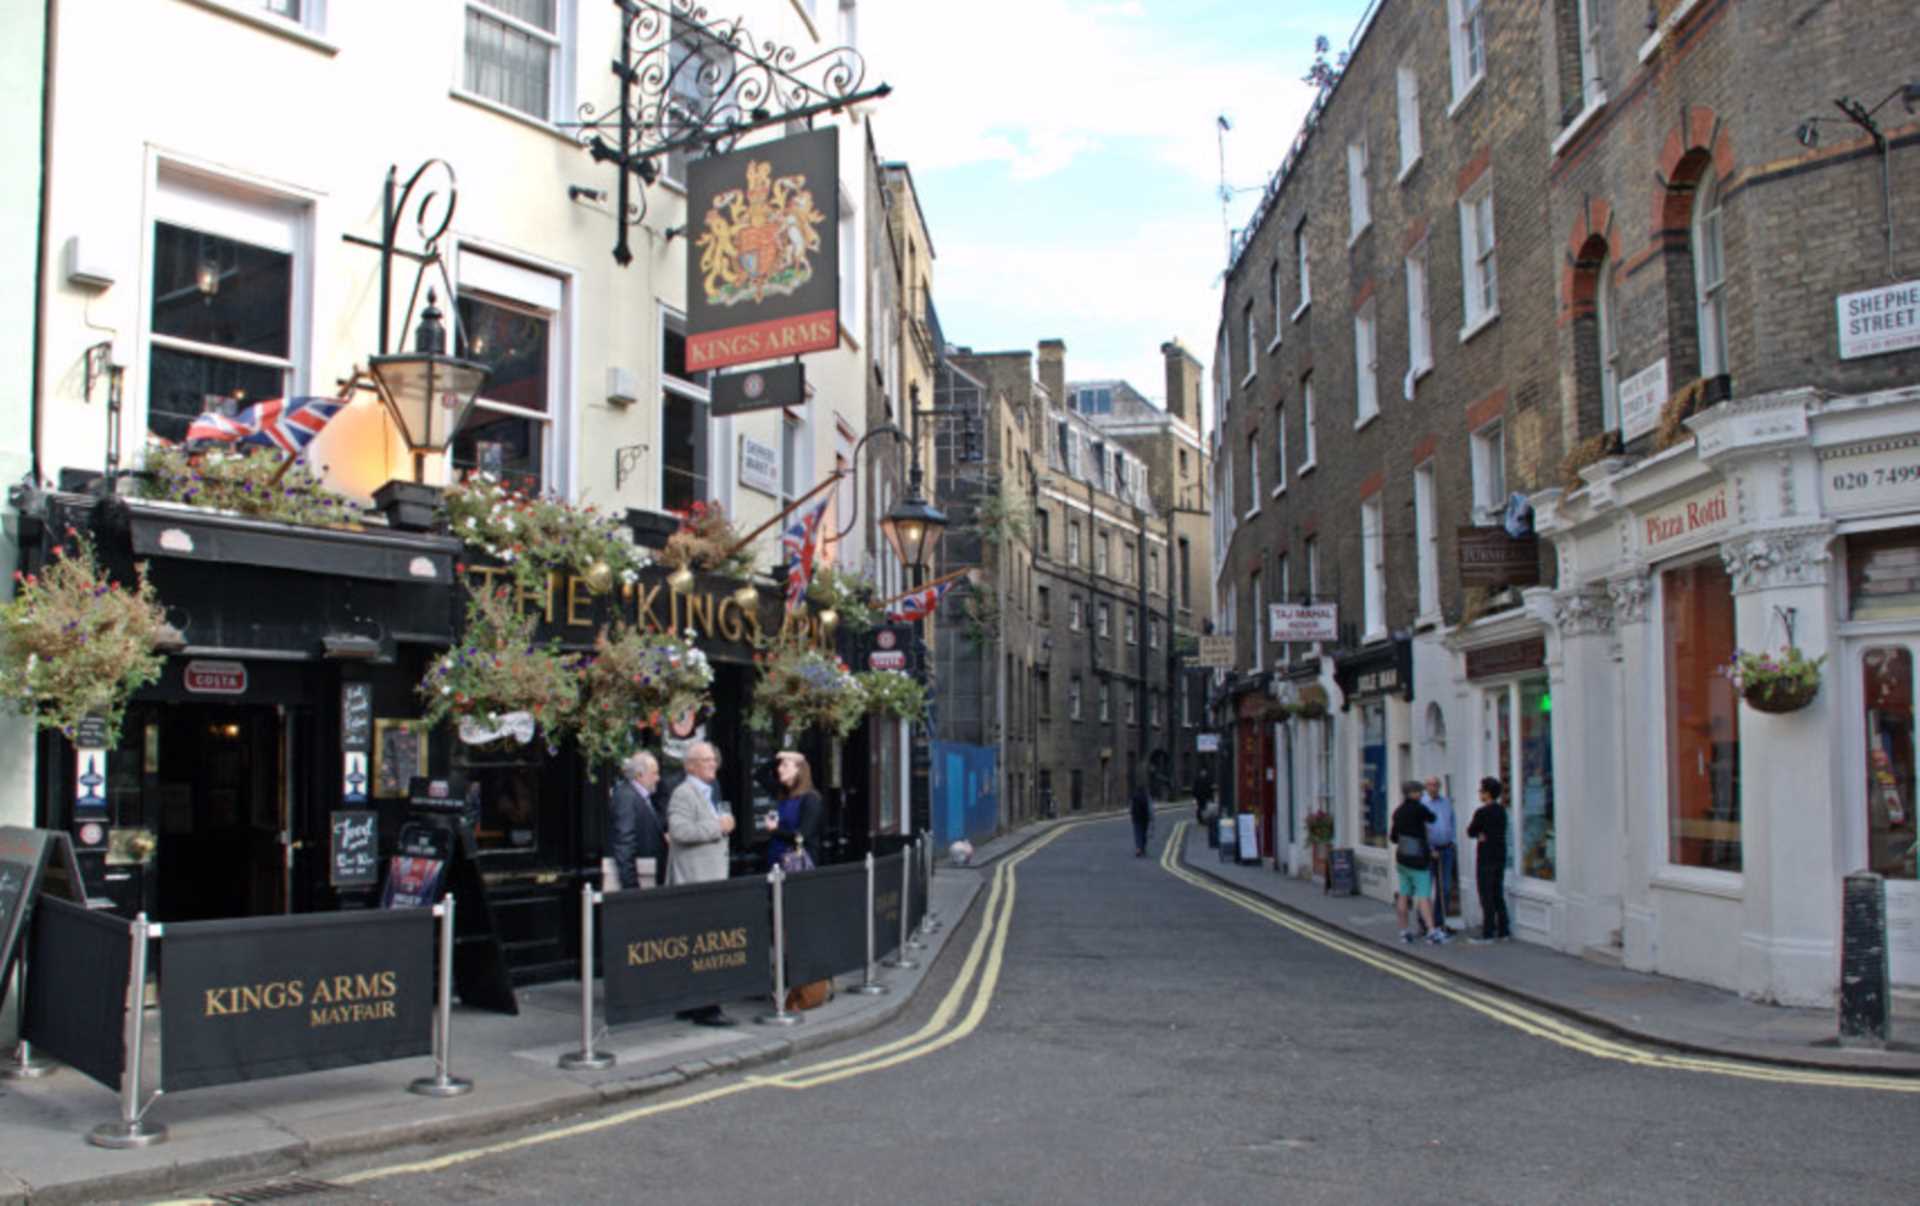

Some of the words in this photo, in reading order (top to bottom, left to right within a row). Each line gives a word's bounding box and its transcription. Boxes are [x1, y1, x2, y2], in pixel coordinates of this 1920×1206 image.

[1849, 308, 1914, 335] STREET
[691, 332, 760, 363] KINGS
[767, 319, 832, 348] ARMS
[1833, 471, 1869, 491] 020
[1874, 463, 1920, 485] 7499
[1646, 512, 1684, 545] Pizza
[1687, 486, 1728, 531] Rotti
[1275, 608, 1294, 619] TAJ
[195, 673, 237, 688] COSTA
[627, 935, 688, 966] KINGS
[691, 926, 748, 955] ARMS
[691, 950, 748, 974] MAYFAIR
[204, 979, 304, 1017] KINGS
[311, 970, 397, 1005] ARMS
[310, 999, 396, 1028] MAYFAIR
